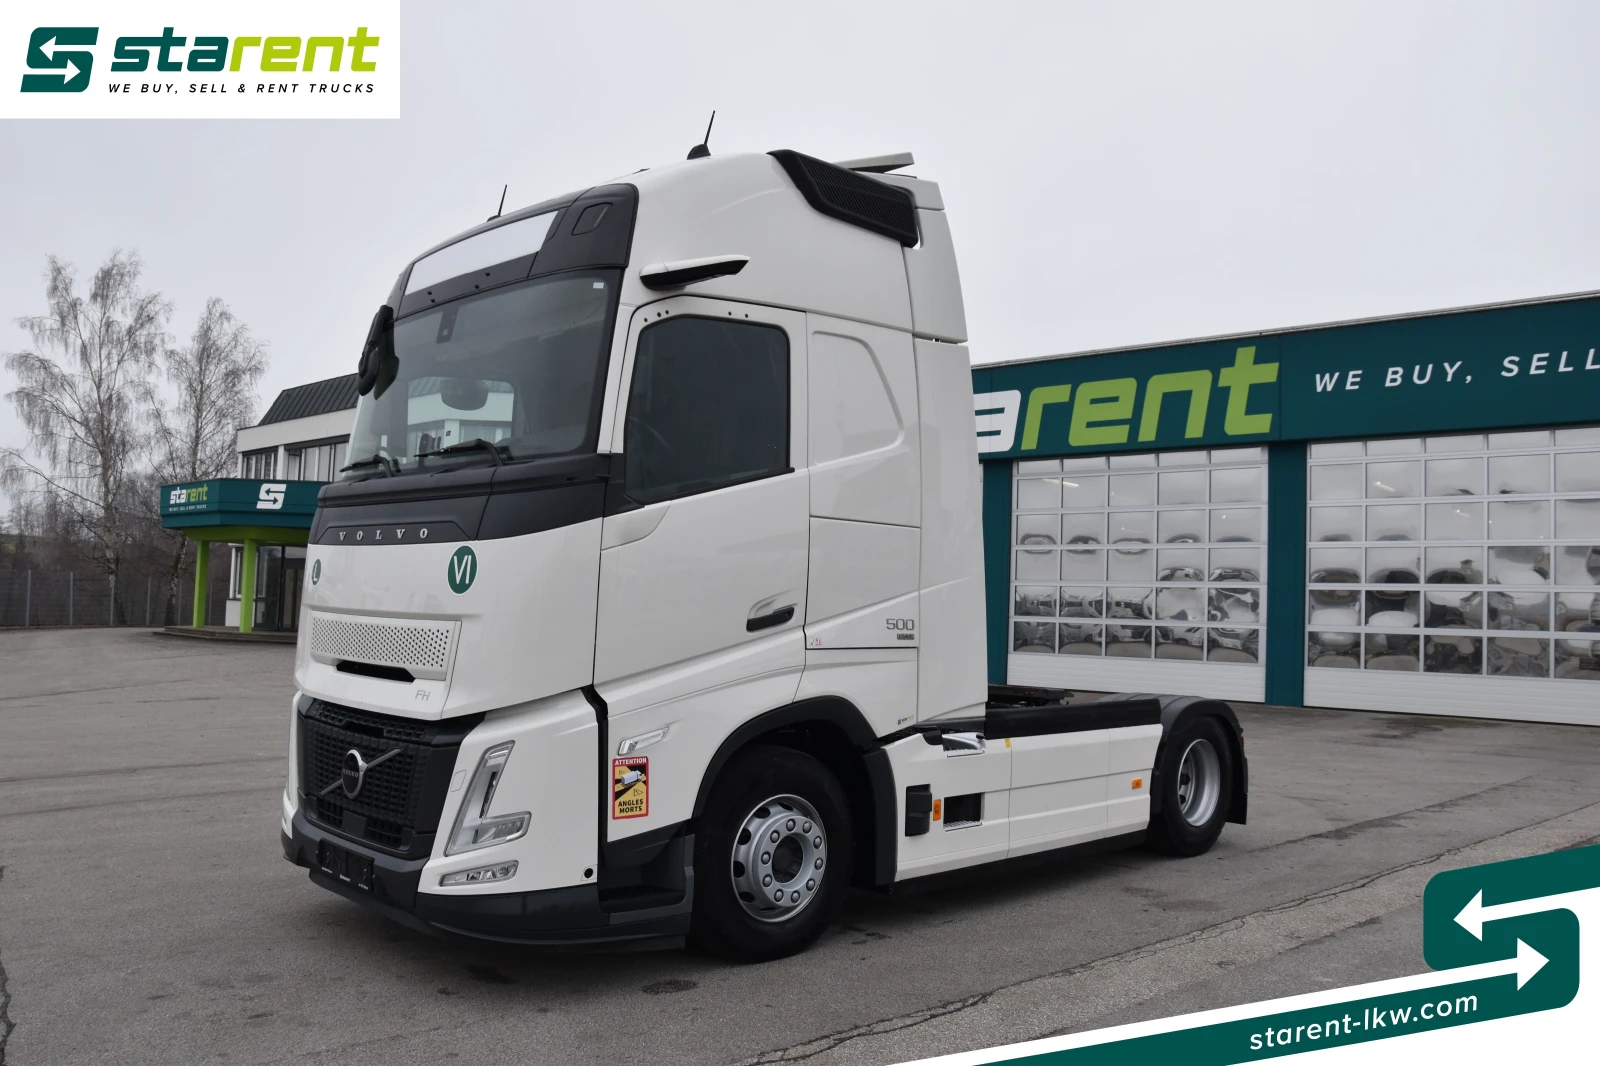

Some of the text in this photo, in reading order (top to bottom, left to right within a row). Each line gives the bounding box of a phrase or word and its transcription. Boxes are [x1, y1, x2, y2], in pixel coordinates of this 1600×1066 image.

[1314, 348, 1600, 393] WE BUY, SELL
[169, 484, 208, 504] starent
[339, 528, 428, 542] VOLVO
[453, 555, 472, 584] VI
[886, 618, 915, 630] 500
[415, 689, 431, 701] FH
[615, 757, 647, 765] ATTENTION
[618, 799, 643, 807] ANGLES
[619, 806, 643, 814] MORTS
